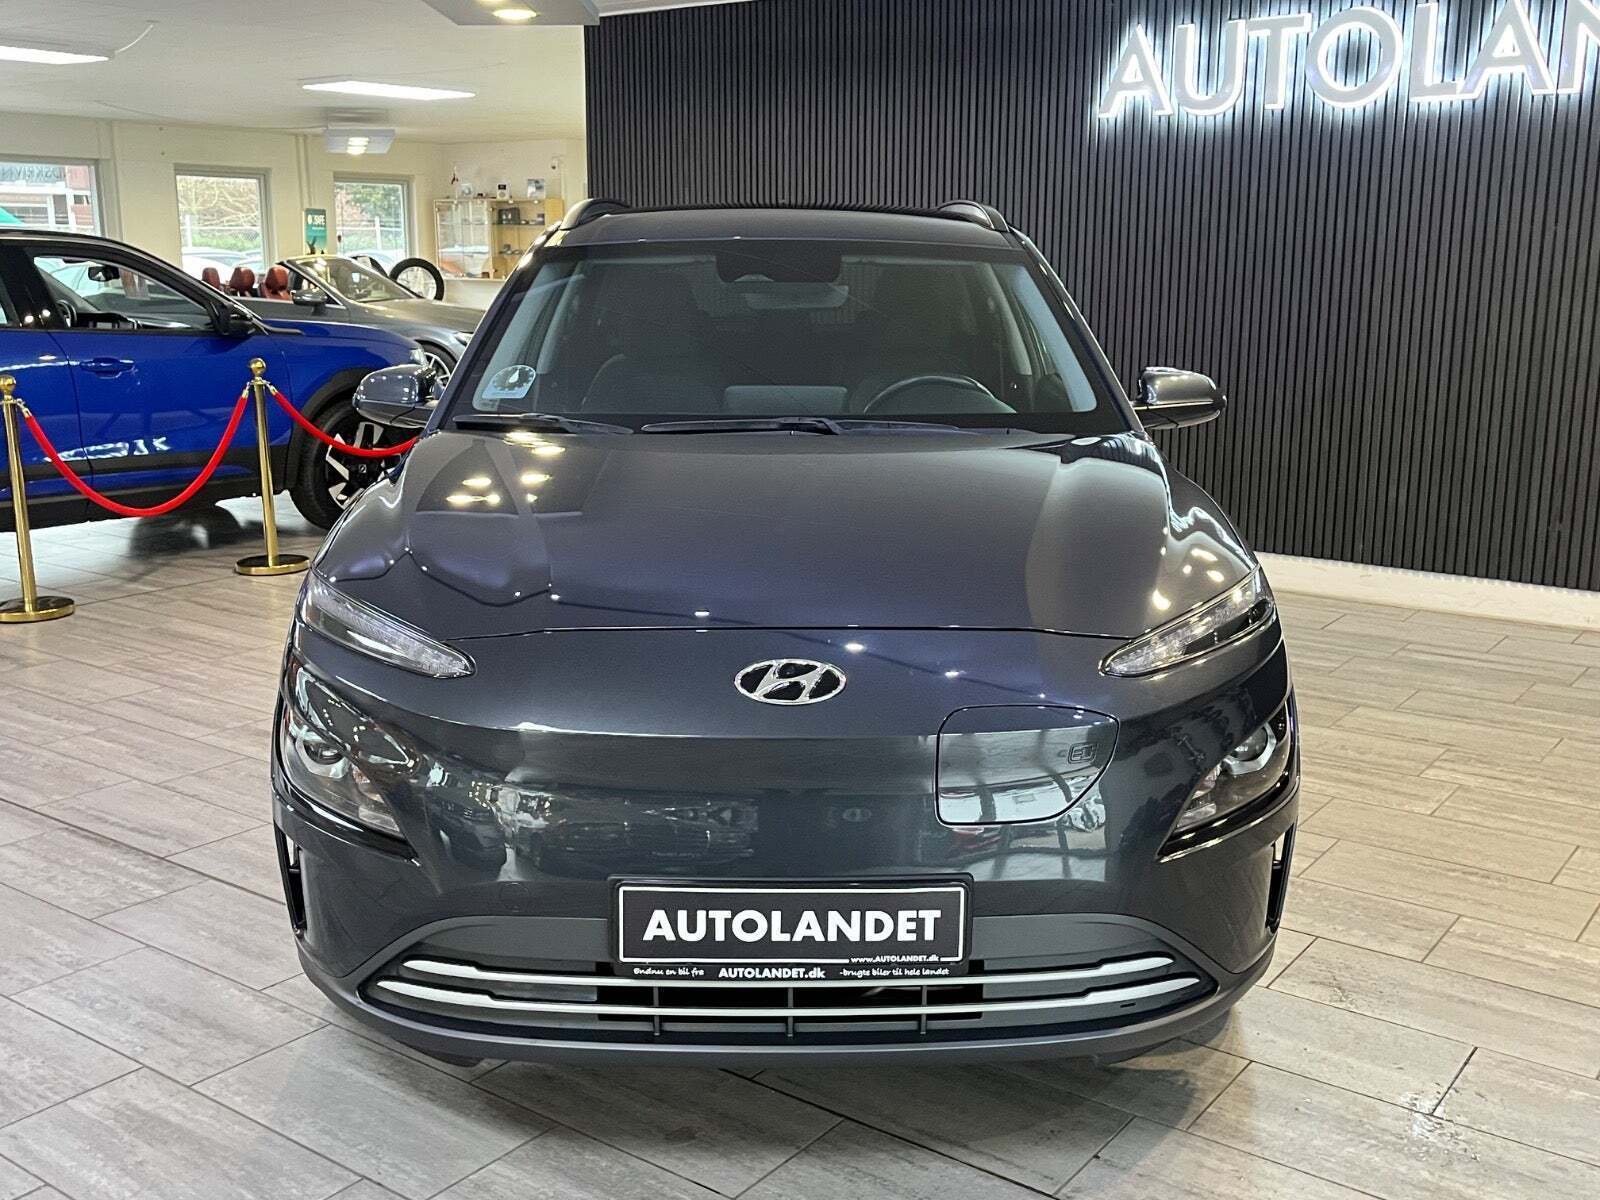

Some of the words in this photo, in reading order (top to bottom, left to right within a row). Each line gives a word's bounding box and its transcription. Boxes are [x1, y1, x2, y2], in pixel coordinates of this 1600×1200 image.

[642, 909, 942, 942] AUTOLANDET
[851, 955, 940, 963] www.AUTOLANDET.dk
[678, 967, 690, 976] bil
[718, 967, 826, 979] AUTOLANDET.dk
[872, 968, 891, 976] biler
[892, 967, 903, 976] til
[904, 967, 921, 976] hele
[922, 967, 950, 976] landet
